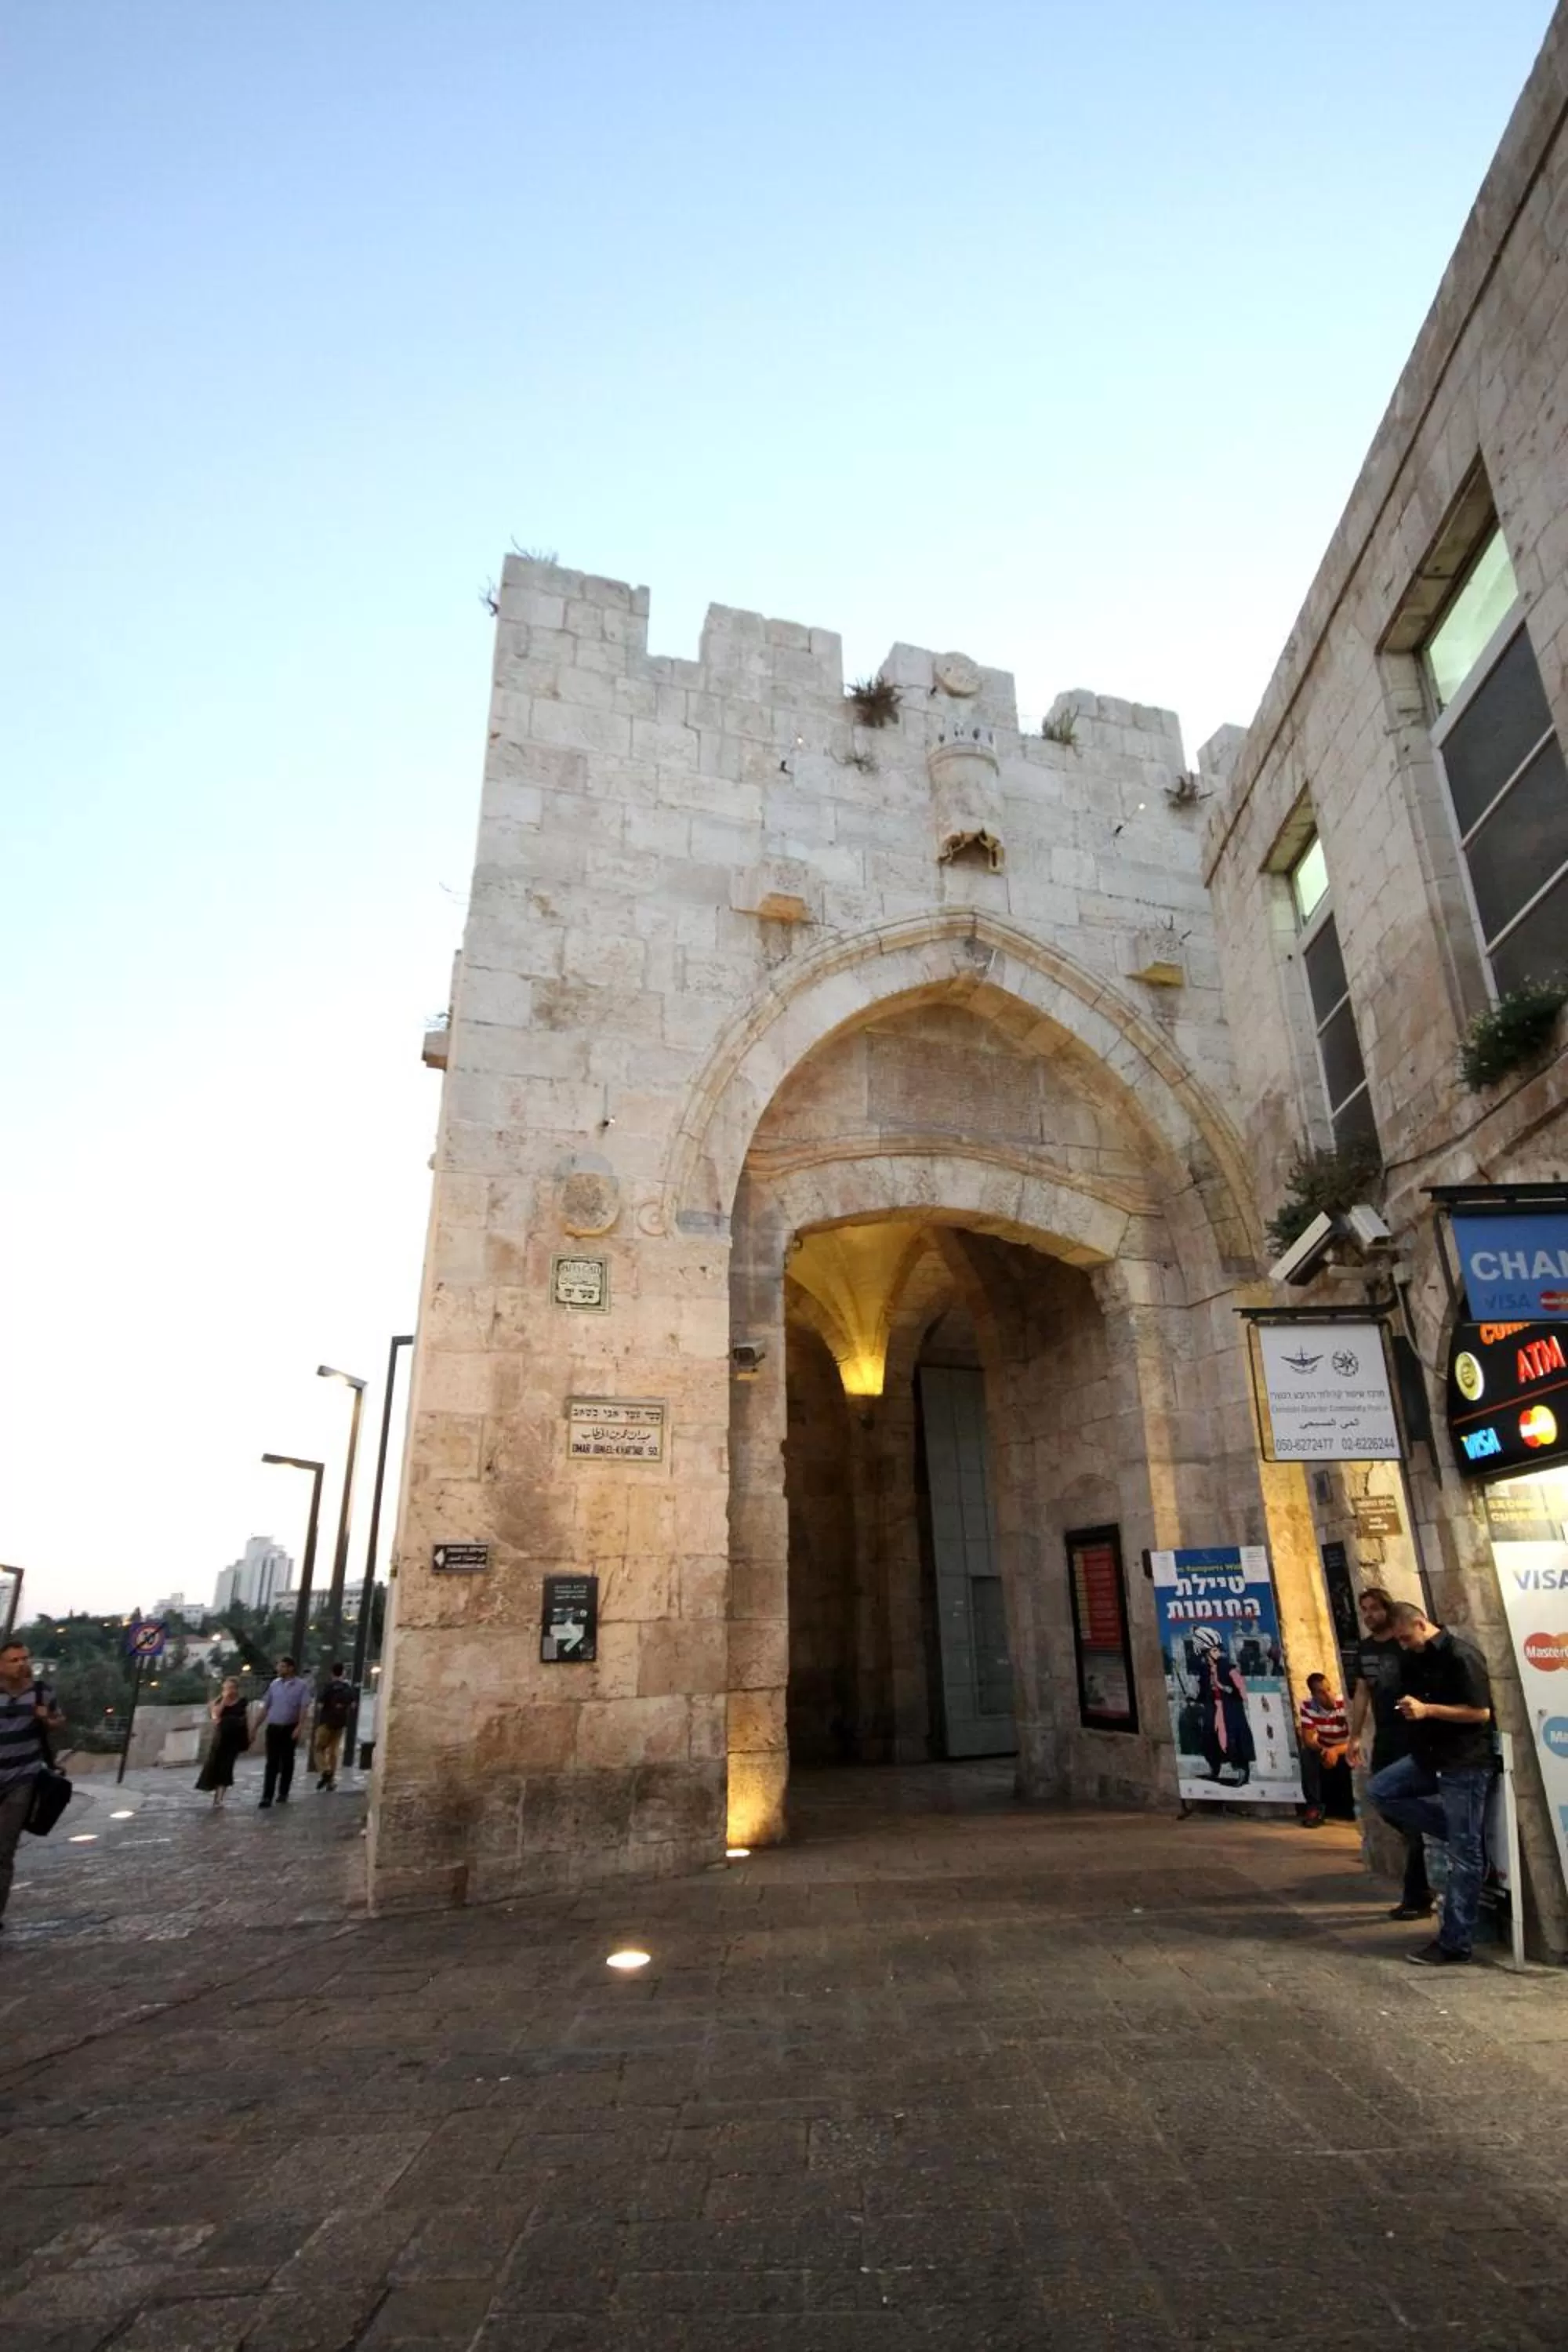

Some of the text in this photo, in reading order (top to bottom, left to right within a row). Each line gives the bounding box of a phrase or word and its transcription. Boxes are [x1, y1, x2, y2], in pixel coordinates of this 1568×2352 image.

[1484, 1294, 1531, 1310] VISA
[1517, 1335, 1566, 1385] ATM
[1461, 1427, 1501, 1460] VISA
[1175, 1573, 1246, 1597] טיילת
[1167, 1598, 1261, 1620] החומות
